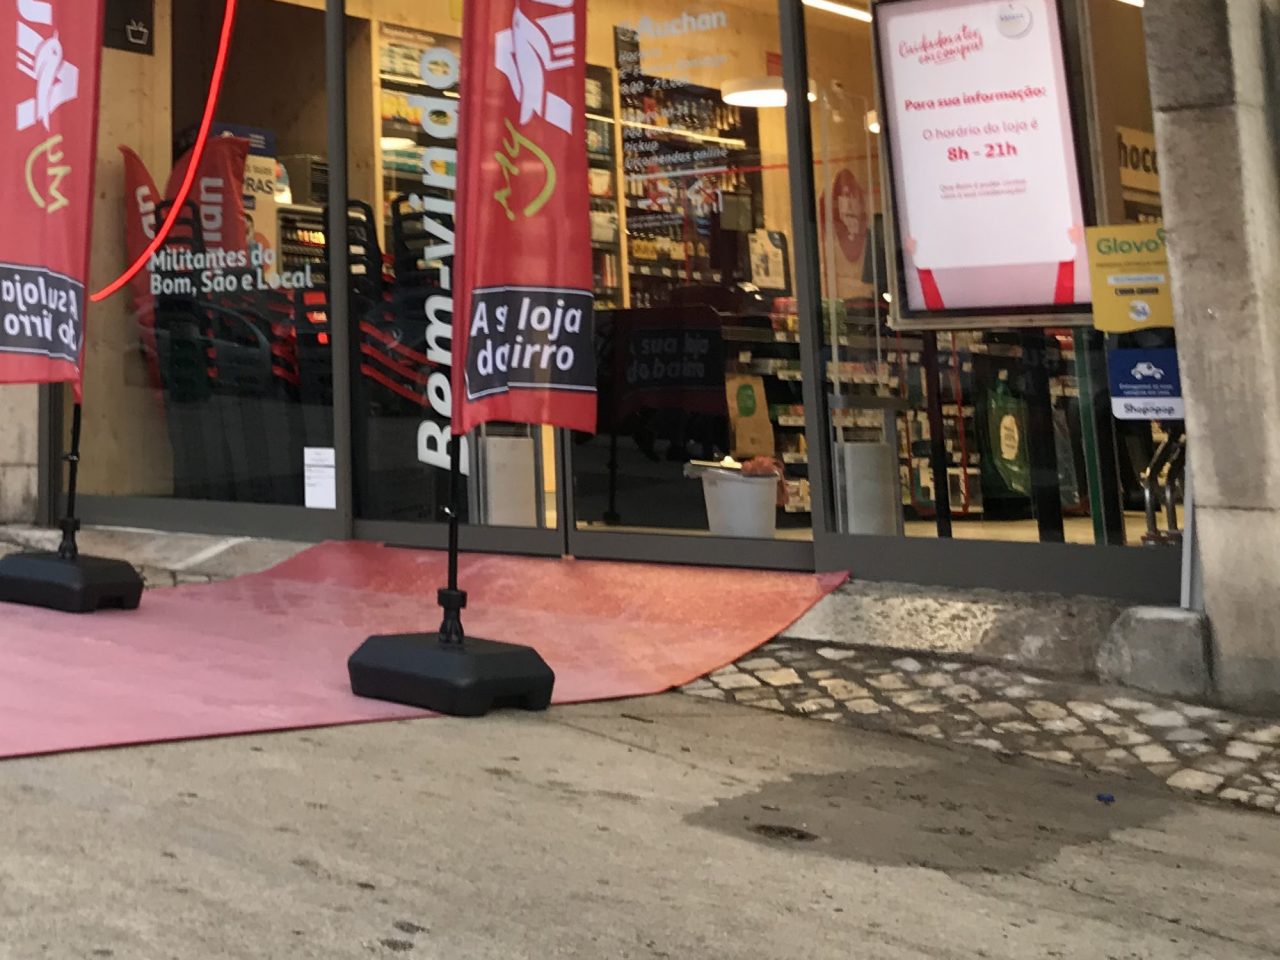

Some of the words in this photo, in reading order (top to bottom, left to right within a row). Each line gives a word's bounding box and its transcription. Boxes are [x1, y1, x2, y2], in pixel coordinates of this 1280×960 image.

[904, 98, 936, 112] Para
[937, 96, 962, 108] sua
[963, 85, 1047, 105] informação:
[922, 128, 933, 141] O
[935, 124, 982, 139] horário
[1003, 119, 1028, 135] loja
[1030, 117, 1039, 130] é
[693, 146, 729, 161] online
[946, 146, 970, 161] 8h
[984, 141, 1018, 158] 21h
[494, 119, 557, 218] My
[148, 246, 247, 272] Militantes
[1096, 237, 1158, 255] Glovo
[150, 272, 197, 297] Bom,
[201, 269, 238, 293] São
[241, 273, 253, 291] e
[256, 263, 314, 290] Local
[518, 297, 582, 341] loja
